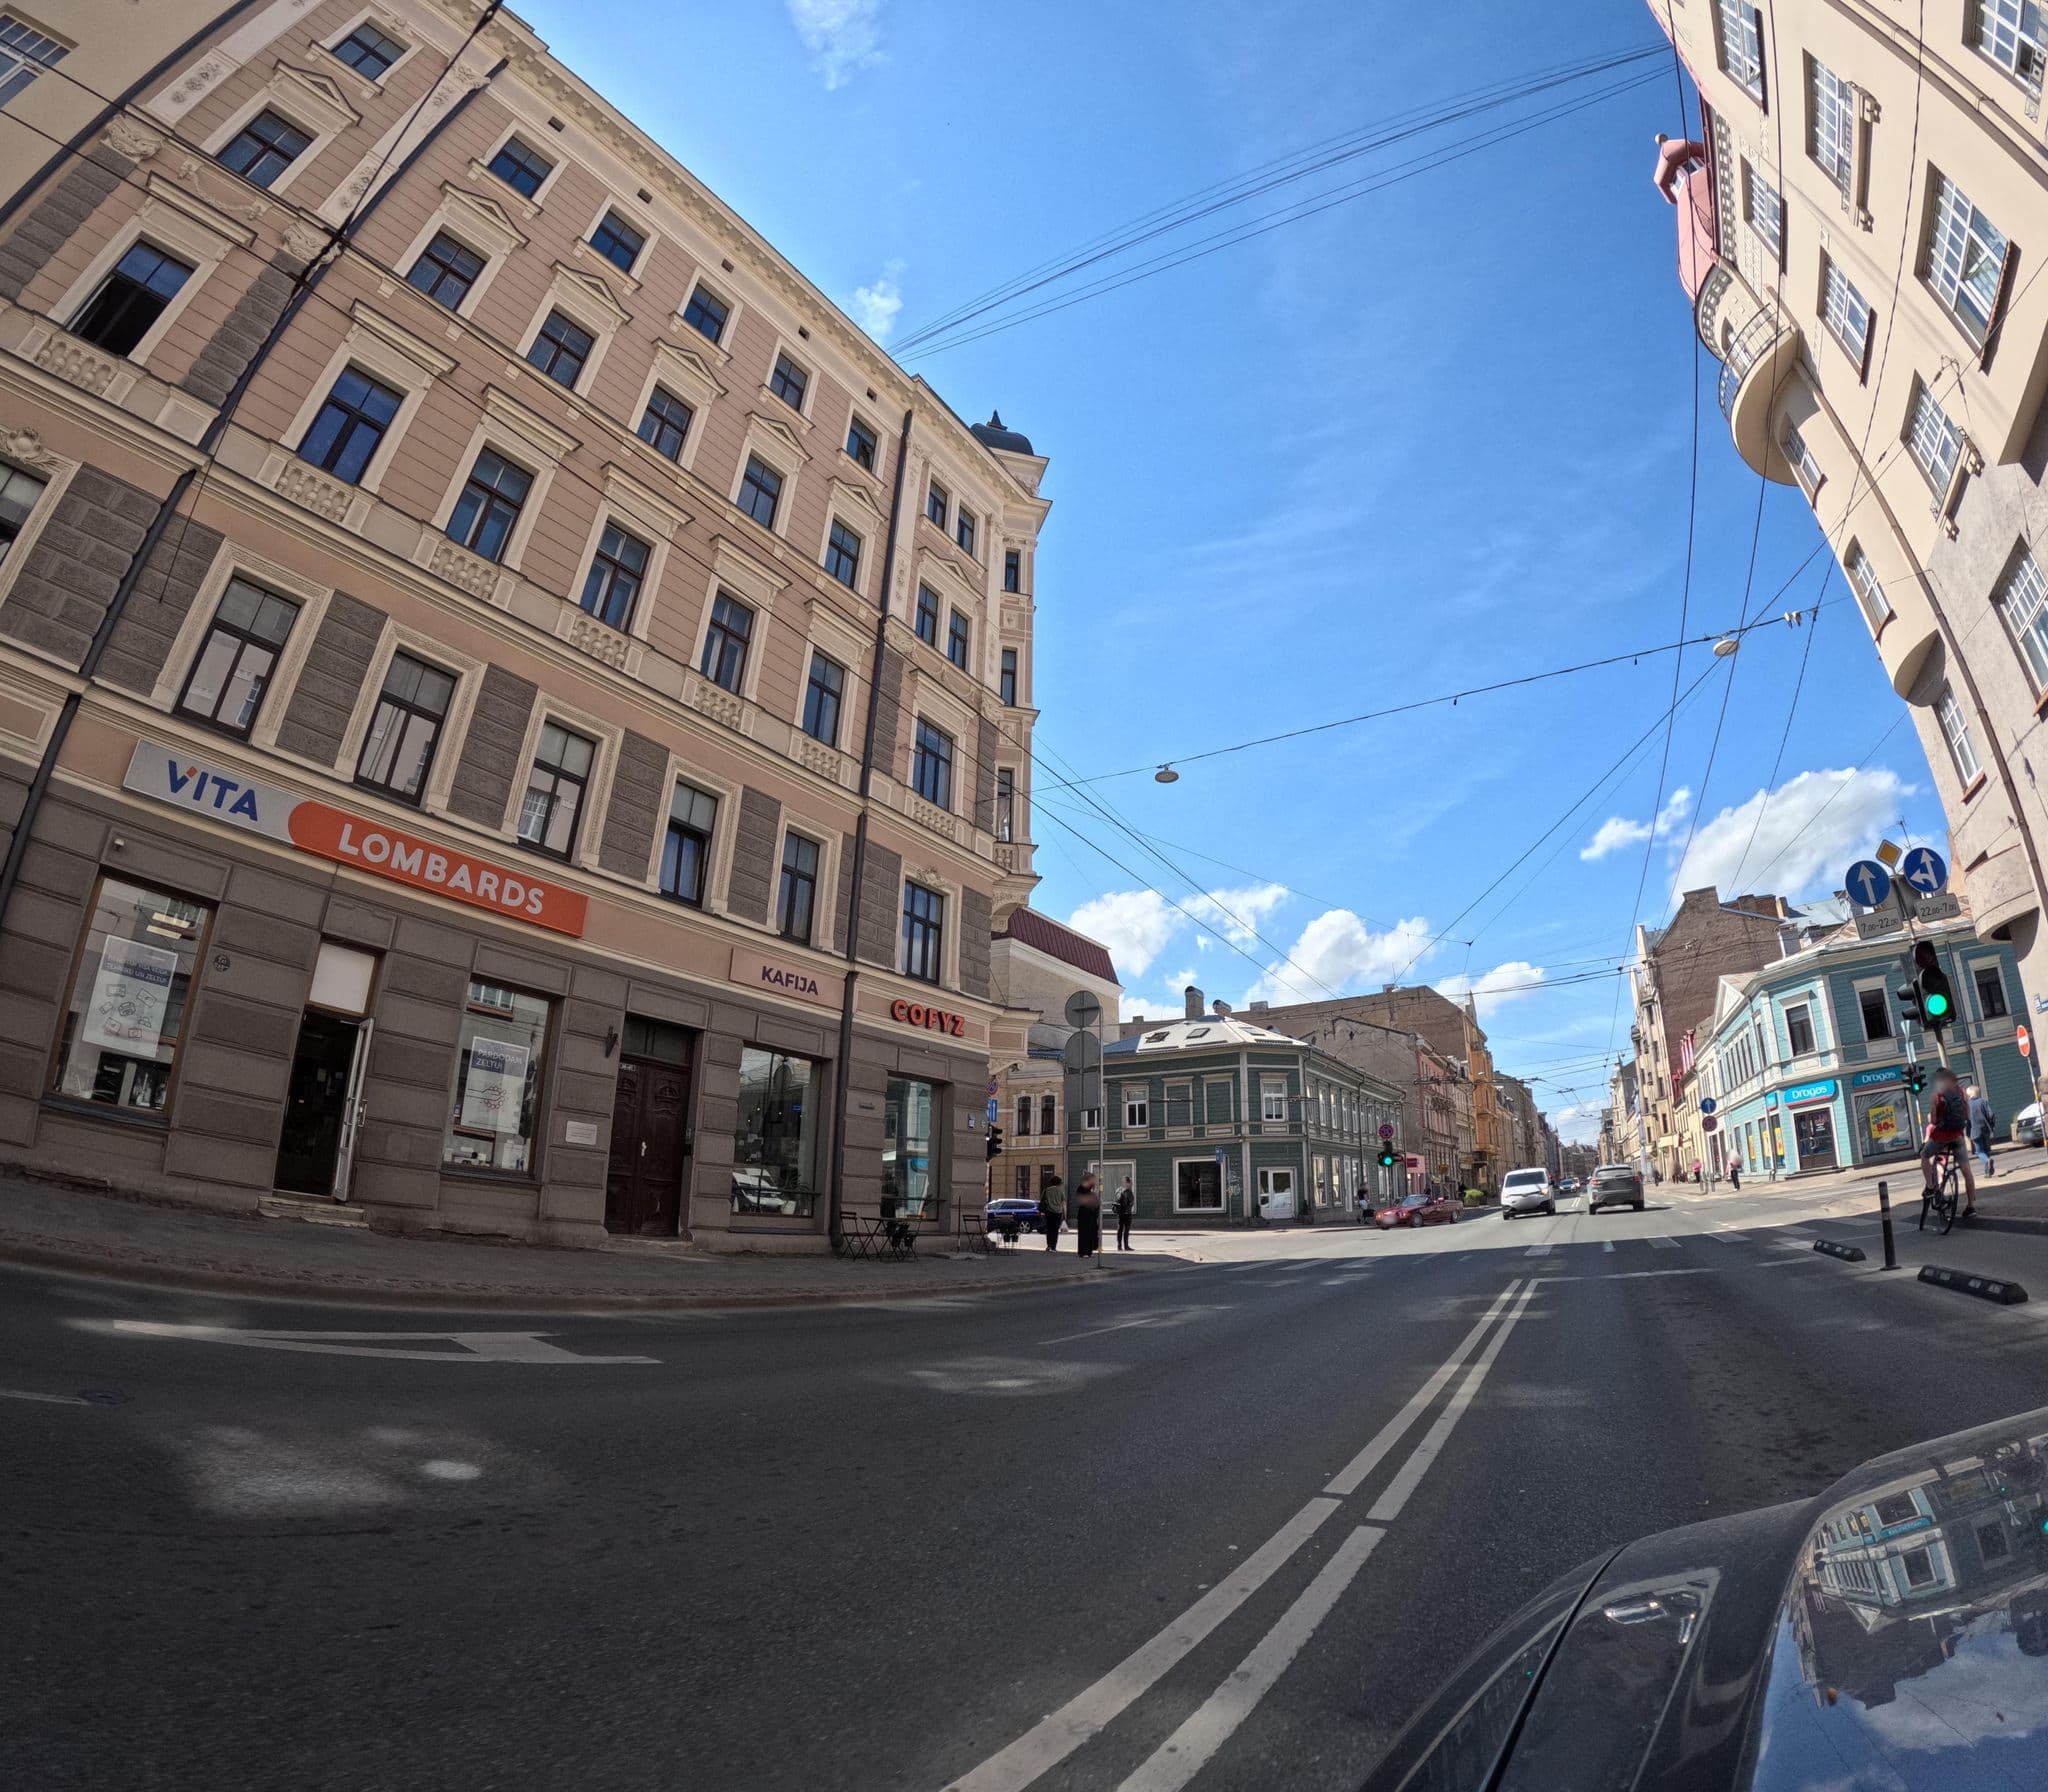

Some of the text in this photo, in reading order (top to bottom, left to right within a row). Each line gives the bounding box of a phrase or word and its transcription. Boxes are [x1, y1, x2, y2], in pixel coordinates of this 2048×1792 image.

[168, 760, 545, 915] VITA LOMBARDS
[761, 965, 819, 996] KAFIJA
[890, 999, 965, 1037] COFYZ
[1791, 1084, 1828, 1099] Drogas
[1861, 1070, 1896, 1084] Drogas
